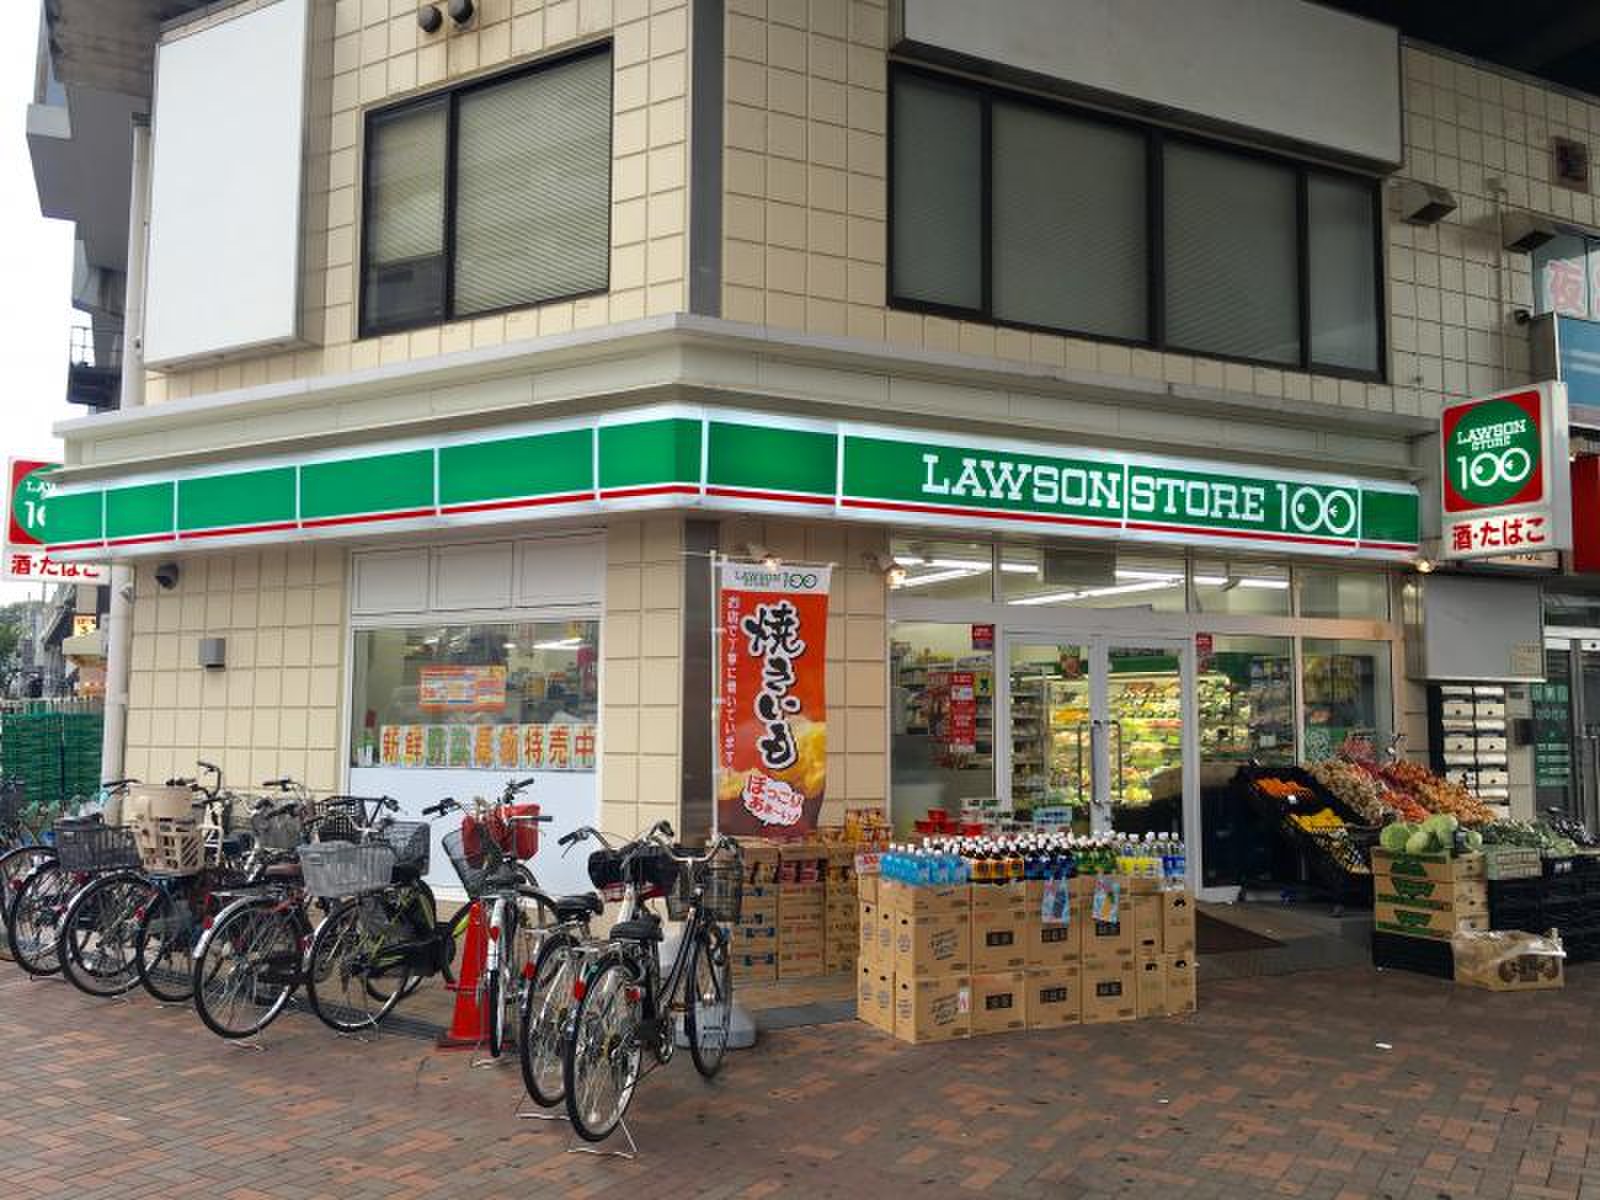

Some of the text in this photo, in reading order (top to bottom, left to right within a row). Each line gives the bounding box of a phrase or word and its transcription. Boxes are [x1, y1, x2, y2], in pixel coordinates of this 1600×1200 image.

[1457, 419, 1526, 444] LAWSON
[1472, 435, 1511, 451] STORE
[1456, 447, 1531, 491] 100
[921, 455, 1357, 535] LAWSON STORE 100
[1453, 517, 1545, 550] 酒・たばこ
[743, 602, 805, 766] 焼きいも
